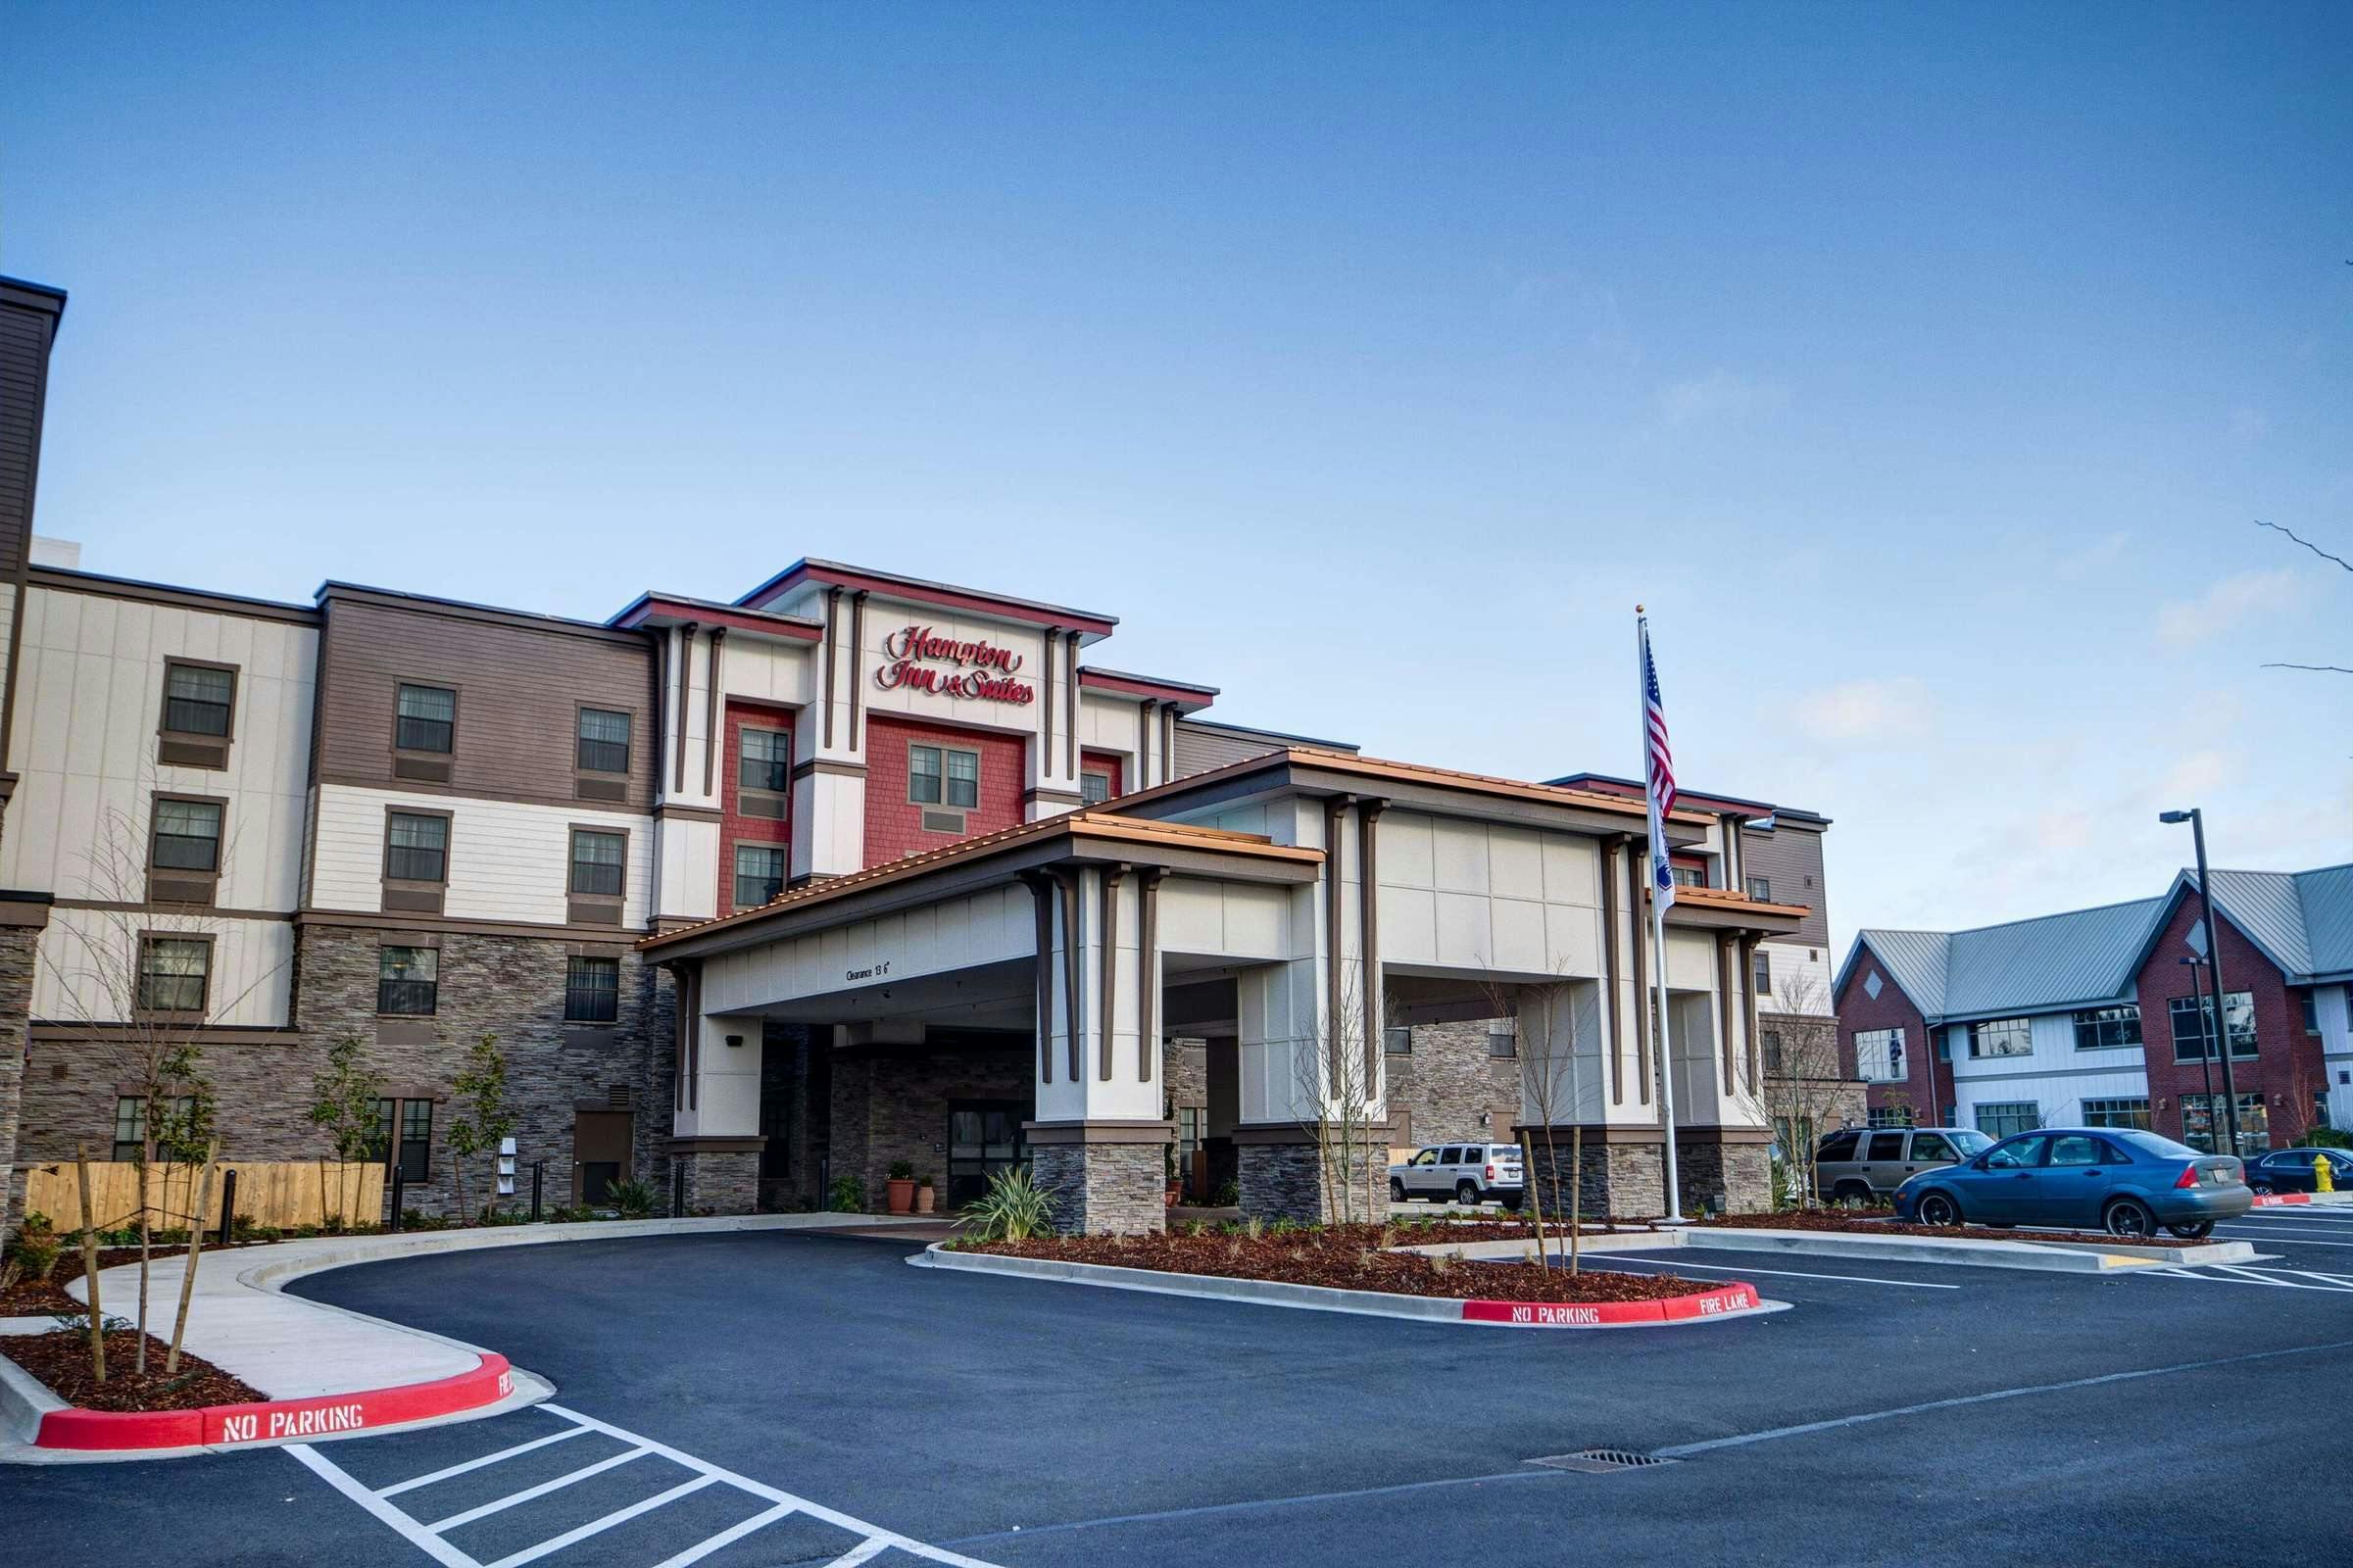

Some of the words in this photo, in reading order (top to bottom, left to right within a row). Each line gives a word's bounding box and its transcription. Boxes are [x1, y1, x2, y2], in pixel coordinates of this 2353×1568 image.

[885, 625, 1022, 673] Hampton
[877, 660, 948, 694] Inn
[947, 674, 965, 698] &
[962, 670, 1034, 704] Suites
[1512, 1305, 1532, 1322] NO
[1538, 1306, 1599, 1324] PARKING
[1700, 1297, 1723, 1314] FIRE
[1723, 1293, 1749, 1311] LANE
[223, 1414, 257, 1443] NO
[270, 1403, 364, 1437] PARKING
